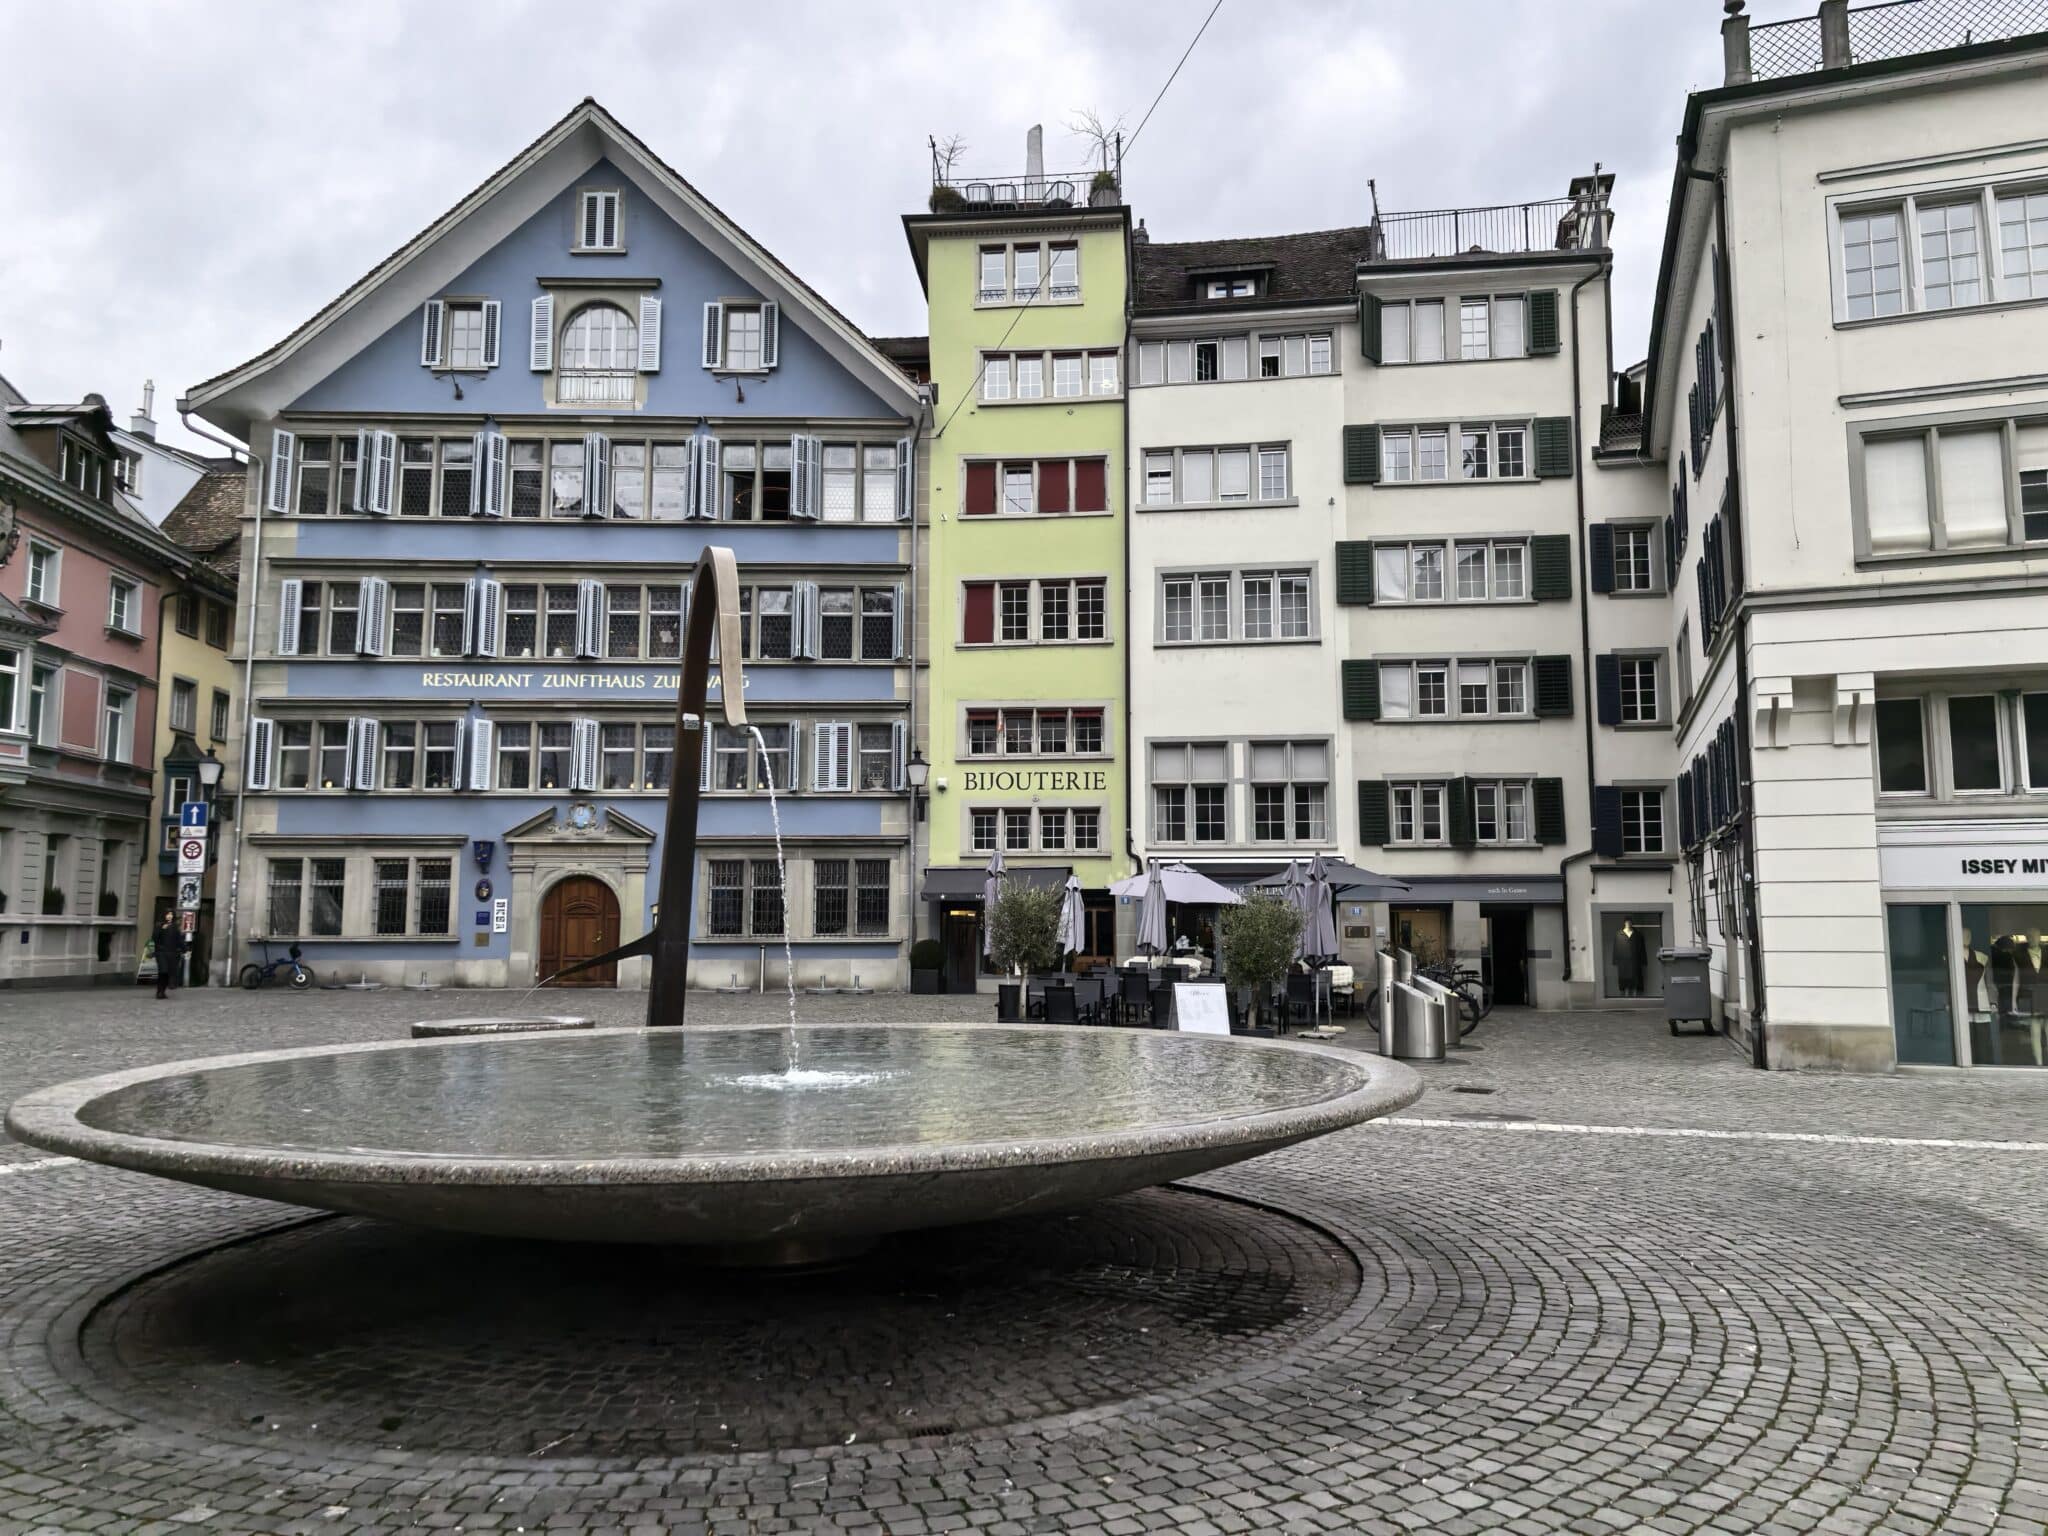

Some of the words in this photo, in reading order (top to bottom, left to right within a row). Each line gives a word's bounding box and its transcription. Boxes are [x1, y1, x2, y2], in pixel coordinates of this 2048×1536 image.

[422, 673, 534, 687] RESTAURANT
[542, 674, 645, 688] ZUNFTHAUS
[653, 675, 680, 689] ZU
[964, 771, 1106, 791] BIJOUTERIE
[1961, 859, 2017, 873] ISSEY
[2022, 858, 2048, 873] MI
